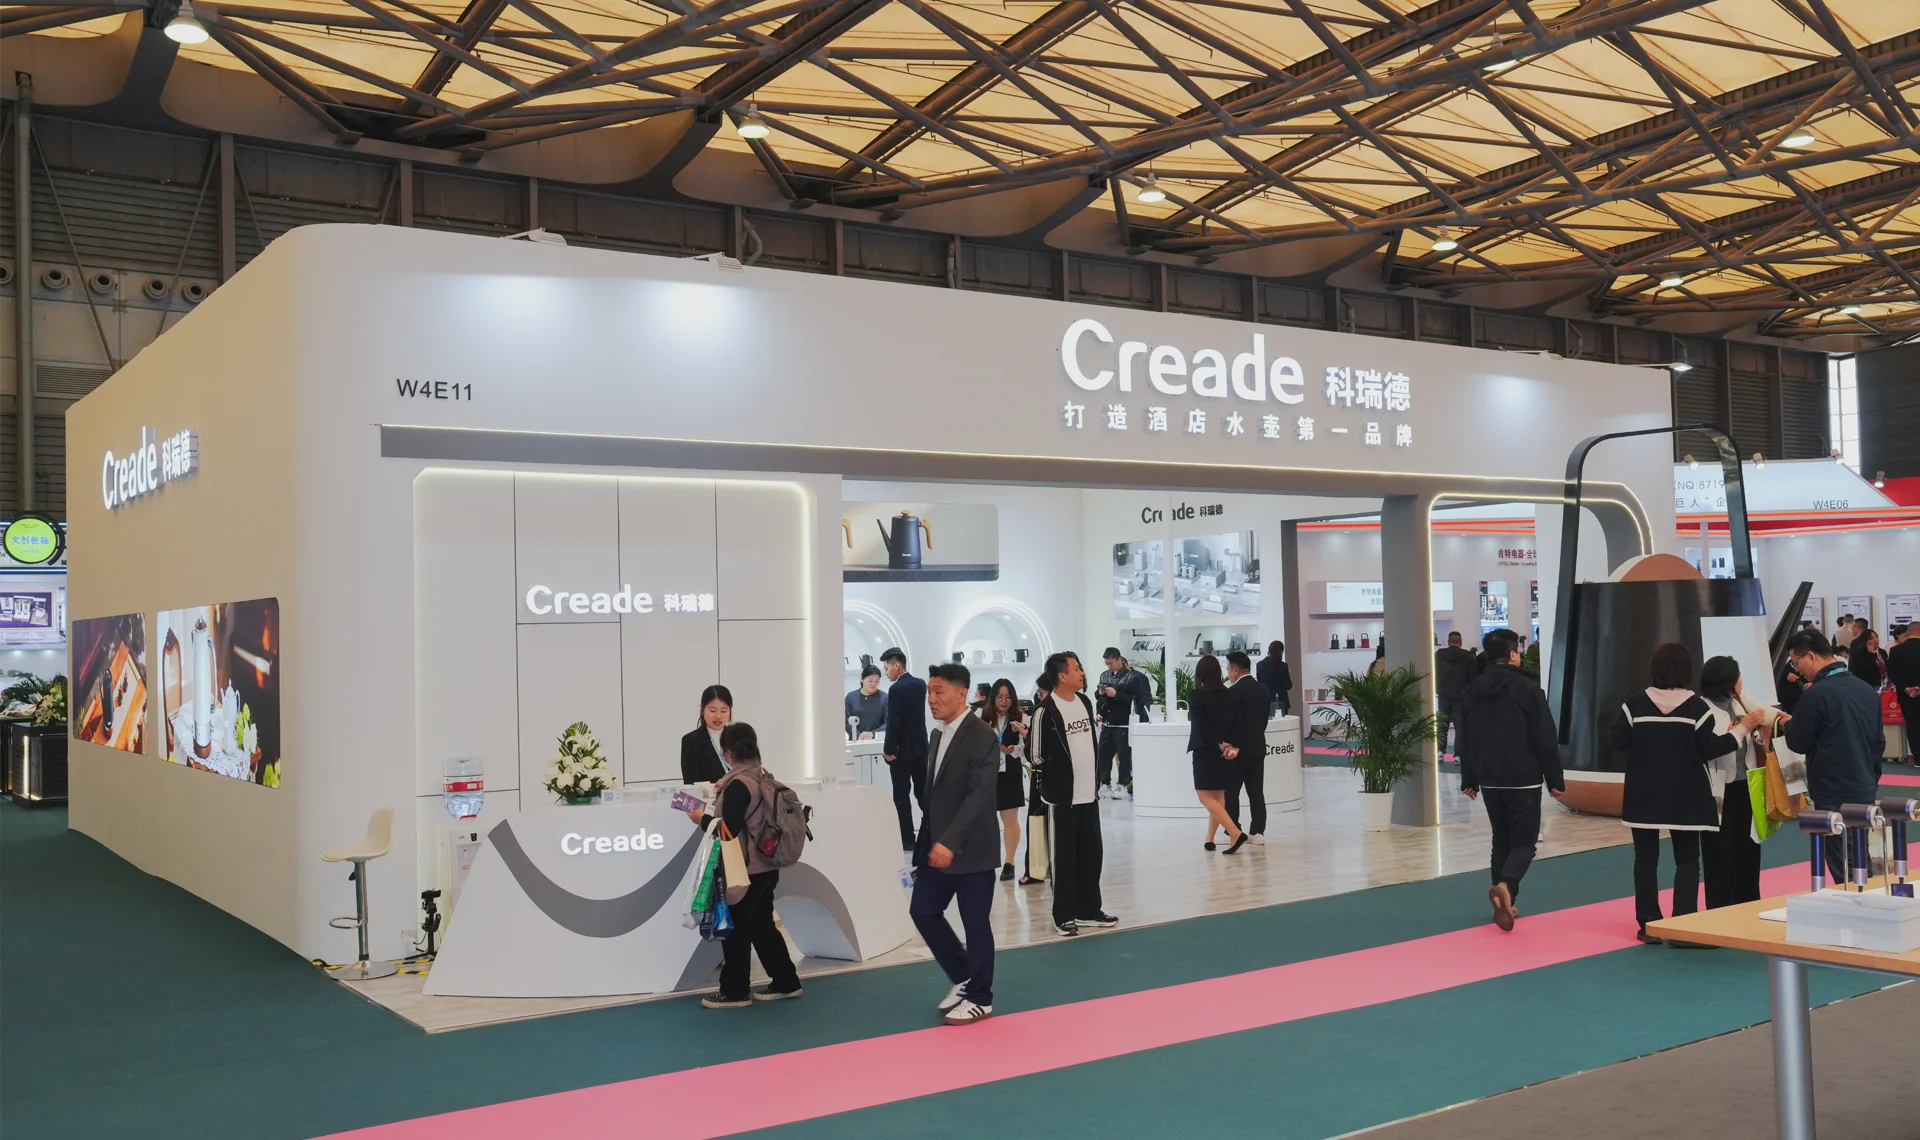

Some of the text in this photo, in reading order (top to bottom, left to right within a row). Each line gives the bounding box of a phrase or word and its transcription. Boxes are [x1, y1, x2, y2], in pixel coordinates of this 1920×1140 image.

[1061, 318, 1412, 411] Creade 科瑞德
[396, 378, 471, 401] W4E11
[1063, 400, 1414, 447] 打造酒店水壶第一品牌
[102, 425, 191, 510] Creade 科瑞德
[1812, 499, 1849, 510] W4E06
[526, 583, 715, 615] Creade 科瑞德
[1265, 741, 1294, 756] Creade
[560, 827, 664, 855] Creade
